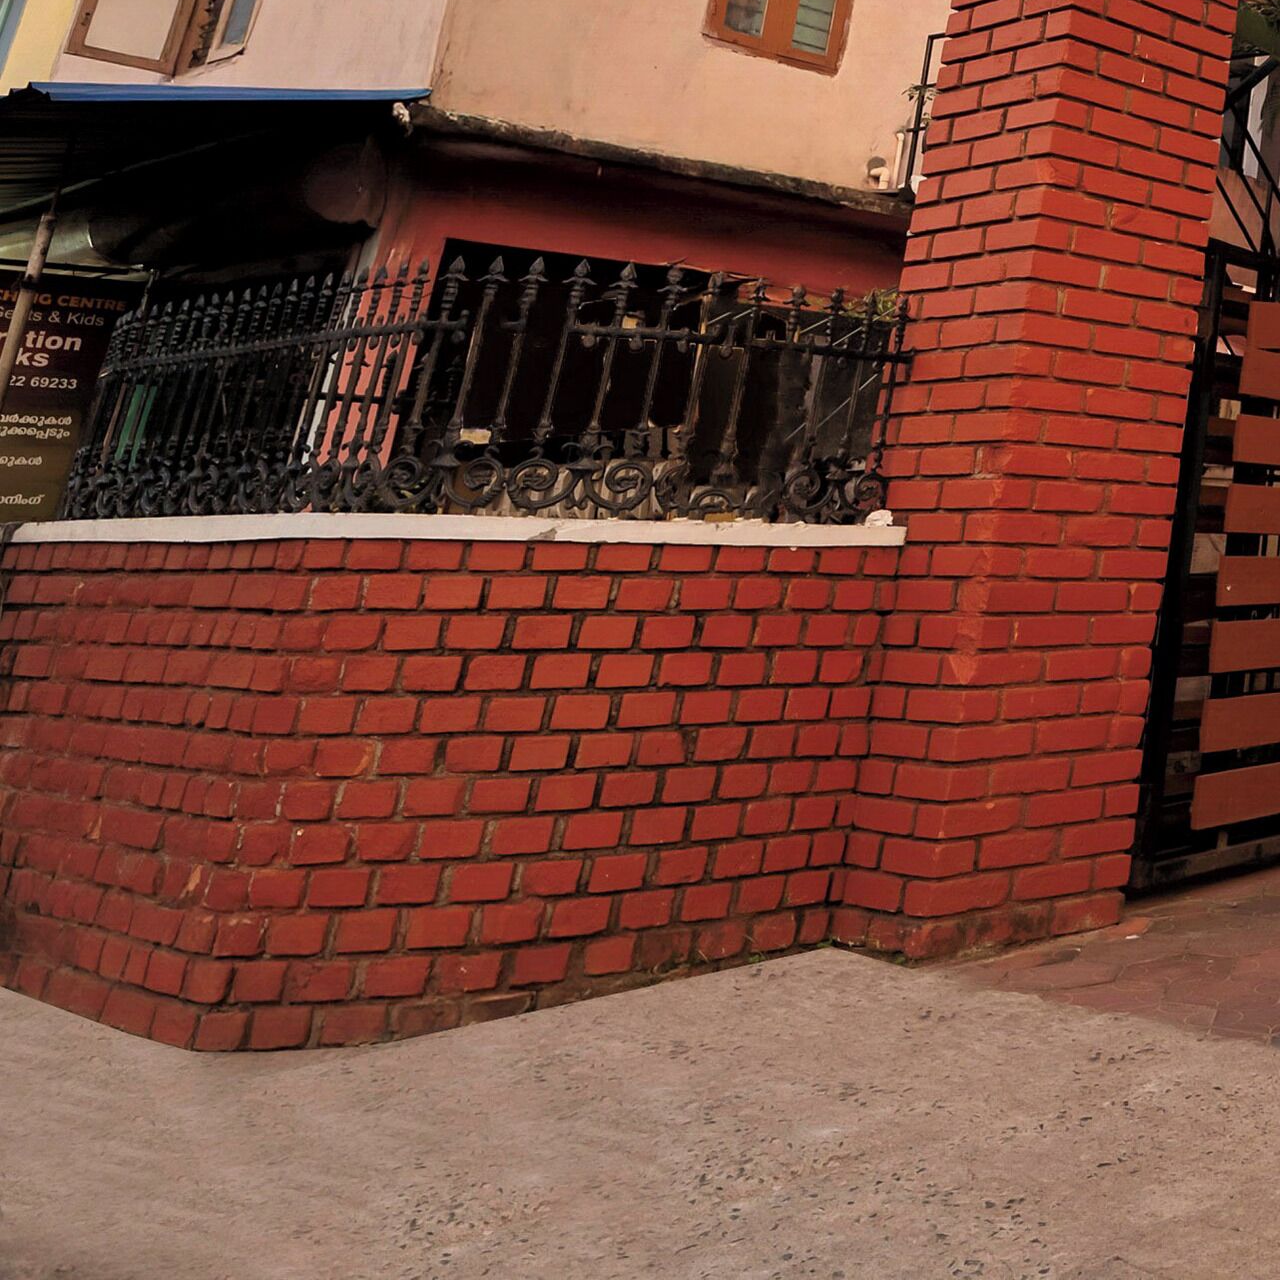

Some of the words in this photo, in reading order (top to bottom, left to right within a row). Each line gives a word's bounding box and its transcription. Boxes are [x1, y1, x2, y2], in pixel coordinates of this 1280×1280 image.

[57, 295, 127, 312] CENTRE
[0, 306, 42, 322] Gets
[48, 311, 60, 323] &
[66, 312, 104, 326] Kids
[30, 376, 78, 389] 69233
